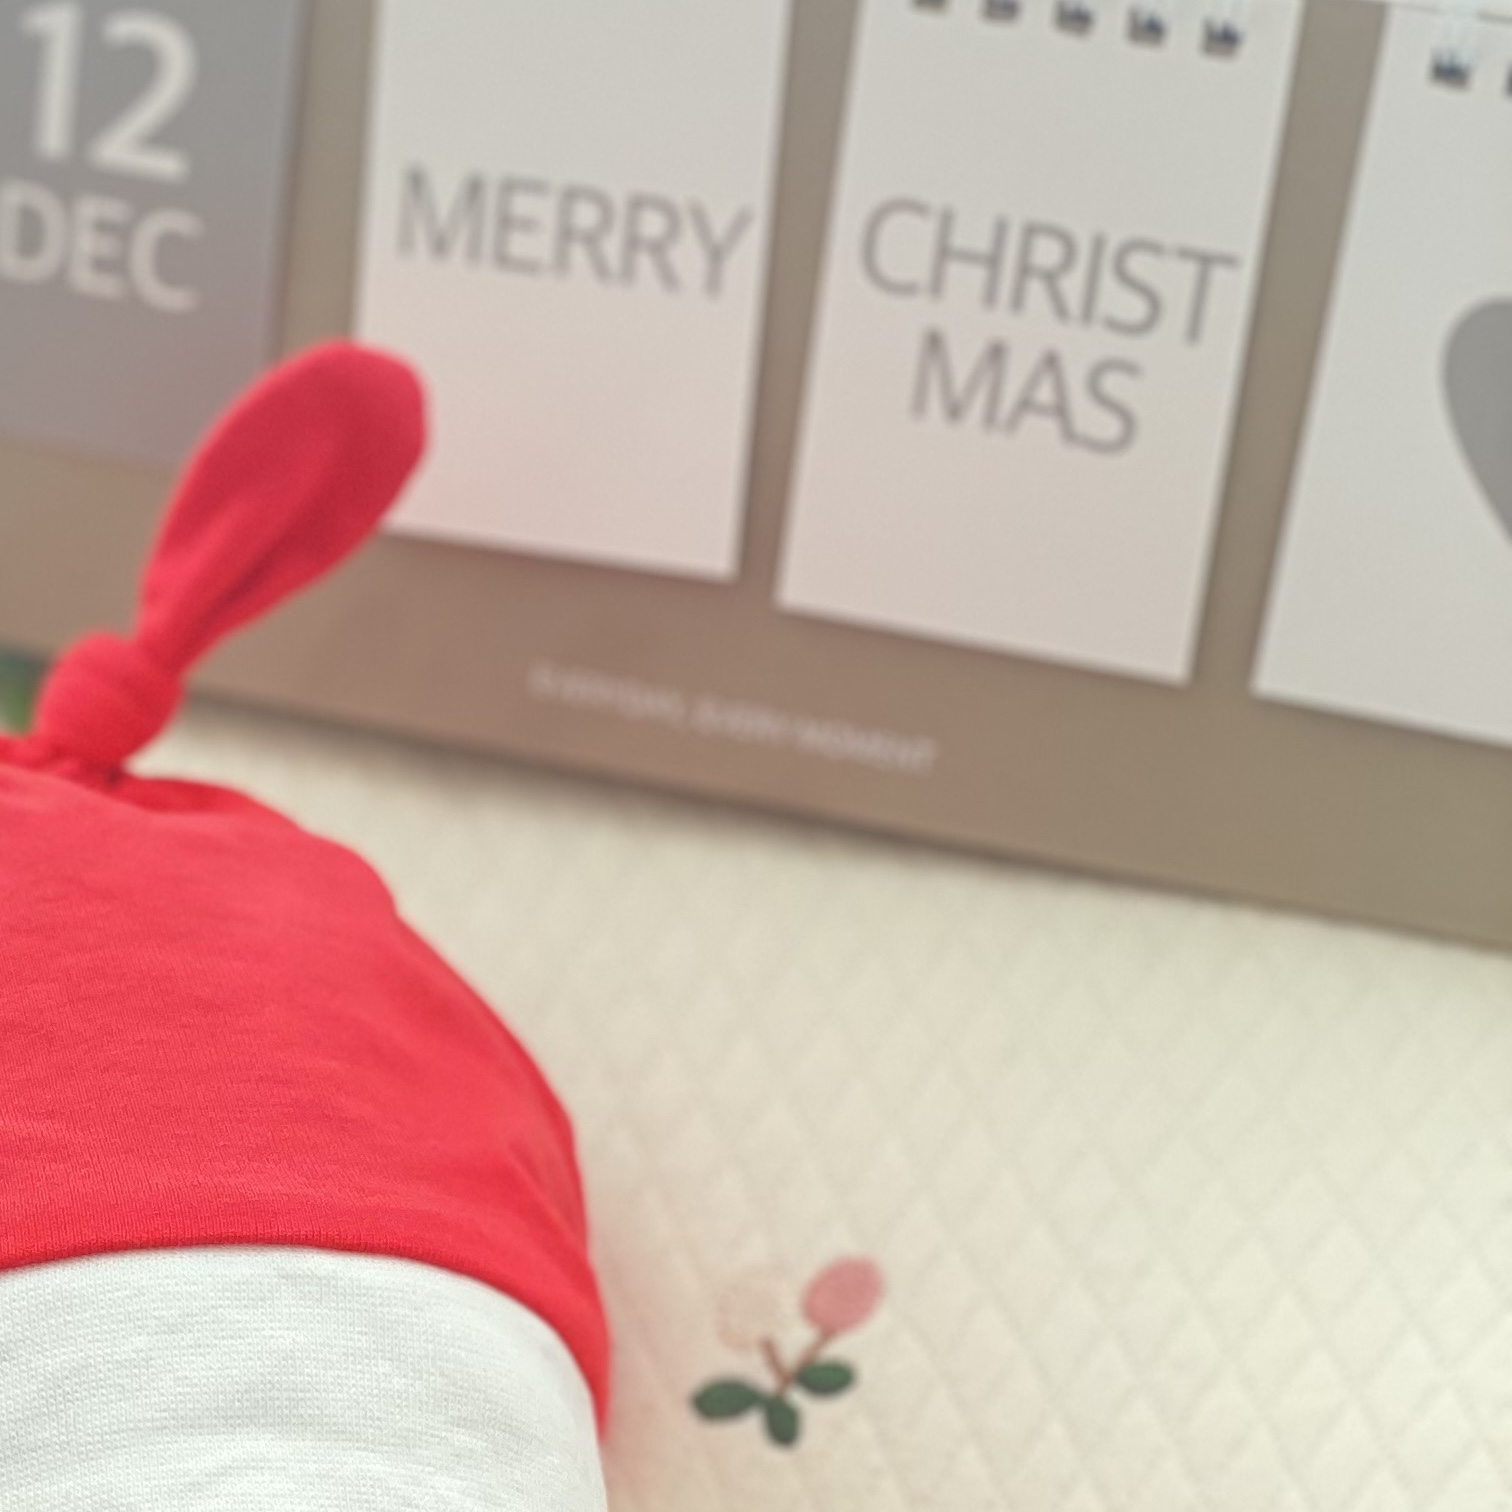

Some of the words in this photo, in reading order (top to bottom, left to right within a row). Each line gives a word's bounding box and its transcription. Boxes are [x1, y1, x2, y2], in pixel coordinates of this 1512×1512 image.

[21, 2, 196, 181] 12
[396, 162, 754, 297] MERRY
[859, 196, 1241, 345] CHRIST
[910, 326, 1142, 456] MAS
